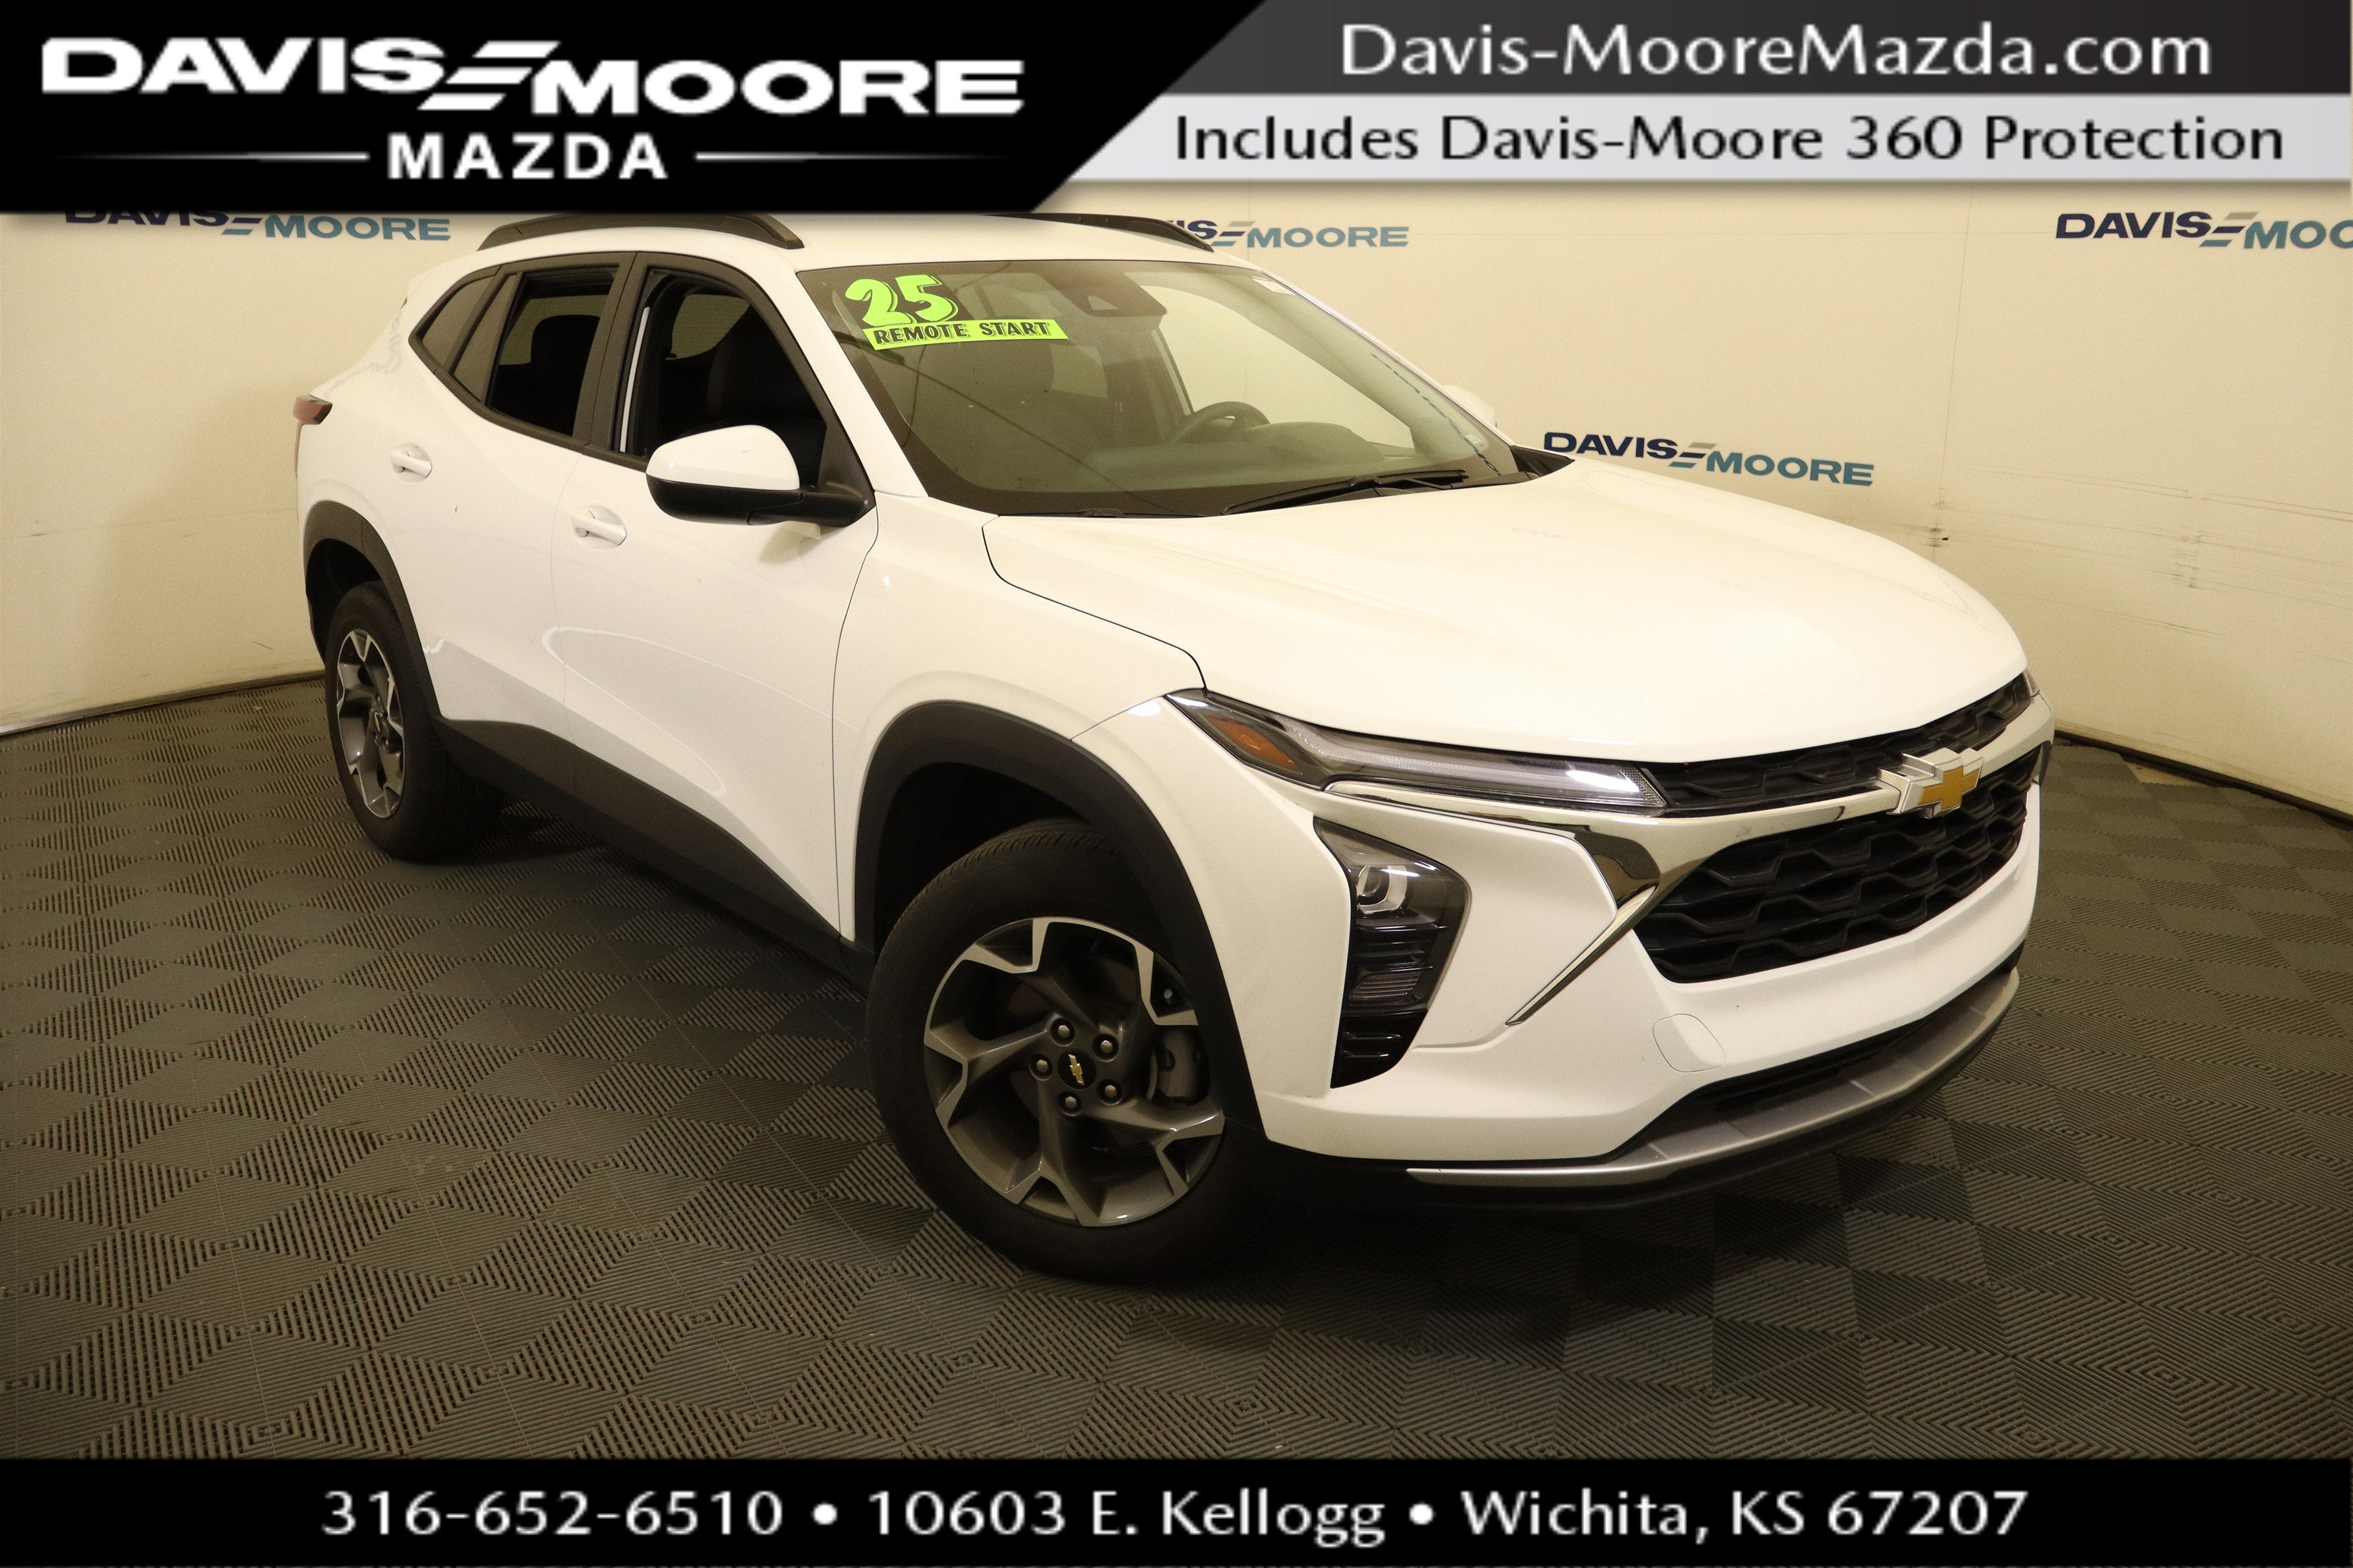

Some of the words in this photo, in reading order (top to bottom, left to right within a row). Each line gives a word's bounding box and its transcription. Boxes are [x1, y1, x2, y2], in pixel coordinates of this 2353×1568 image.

[845, 274, 959, 327] 25
[873, 323, 970, 345] REMOTE
[982, 322, 1050, 337] START
